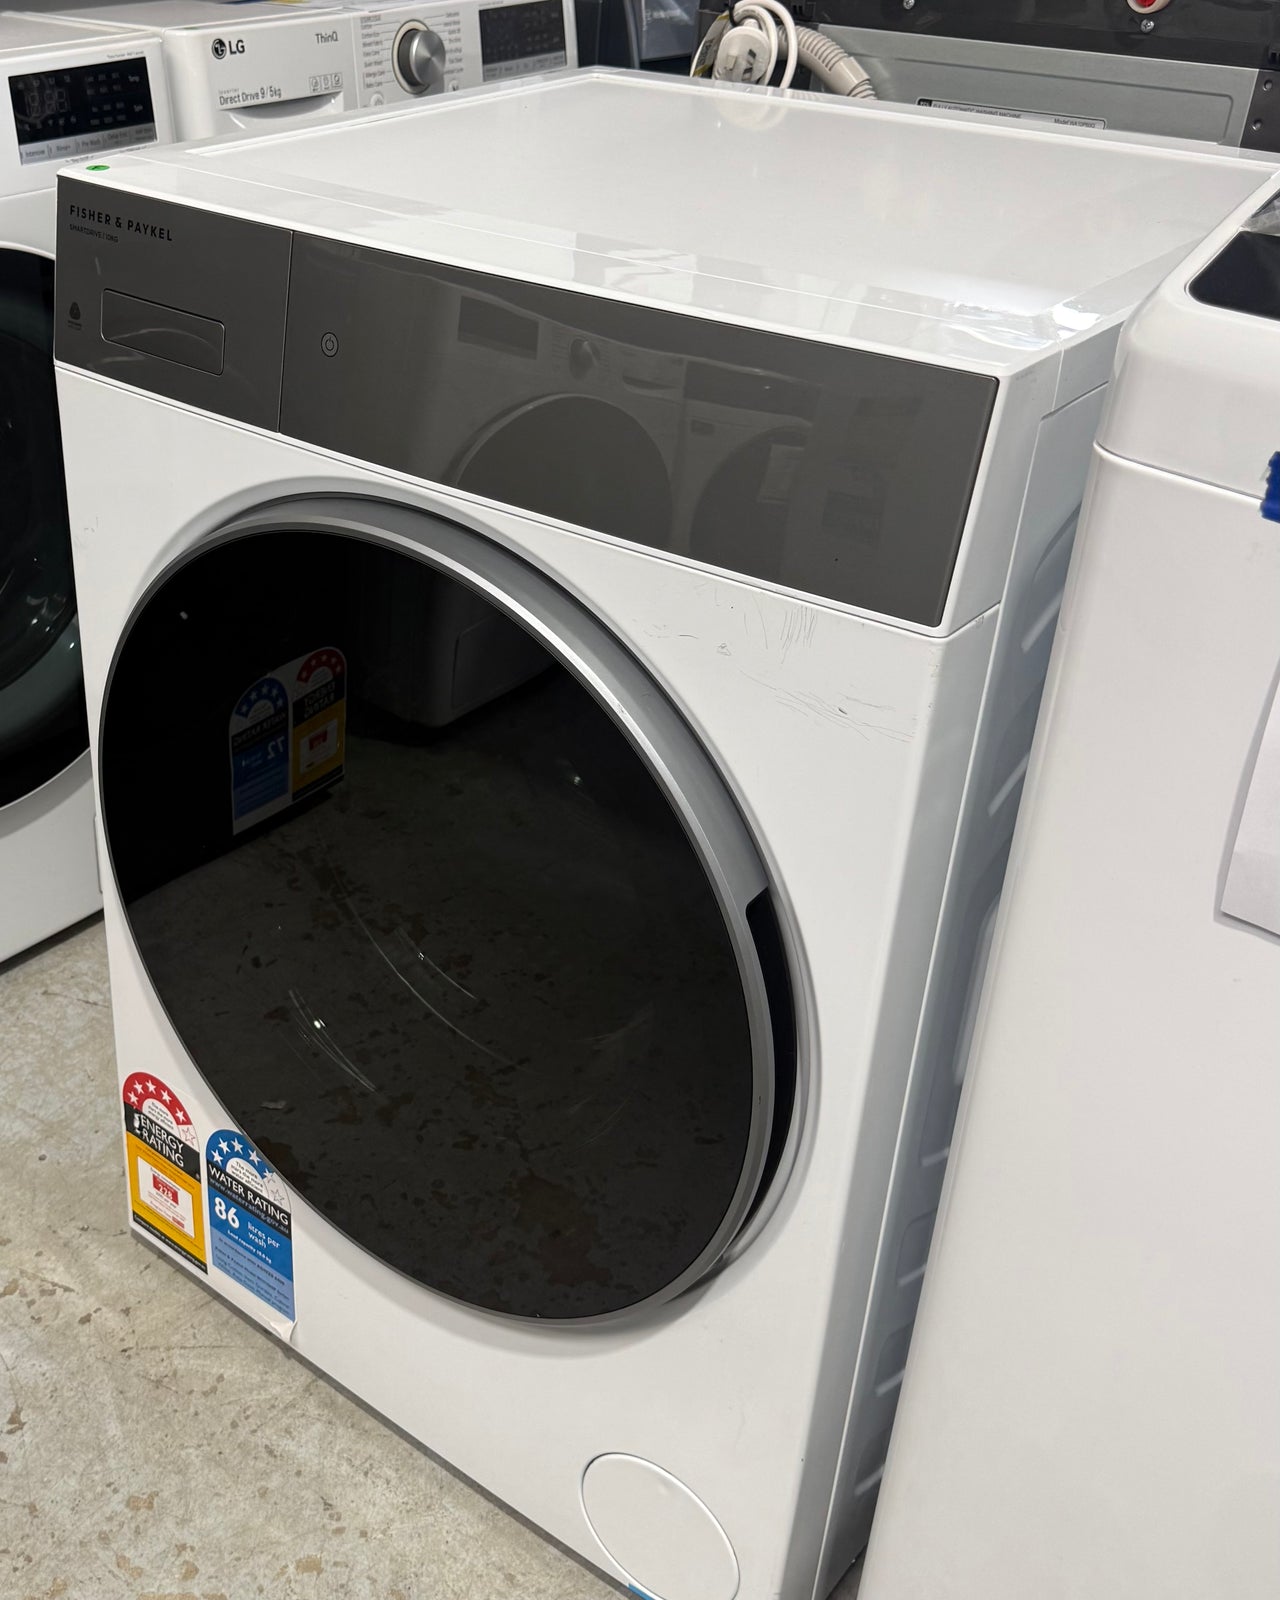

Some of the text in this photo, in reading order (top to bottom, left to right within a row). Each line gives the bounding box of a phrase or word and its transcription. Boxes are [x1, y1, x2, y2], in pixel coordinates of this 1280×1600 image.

[229, 40, 245, 55] LG
[316, 31, 338, 44] ThinQ
[220, 94, 241, 106] Direct
[243, 91, 260, 102] Drive
[70, 204, 173, 242] FISHER & PAYKEL
[141, 1117, 184, 1153] ENERGY
[143, 1129, 184, 1167] RATING
[209, 1164, 289, 1226] WATER RATING
[214, 1197, 240, 1229] 86
[247, 1221, 280, 1248] litres per
[248, 1232, 266, 1248] wash
